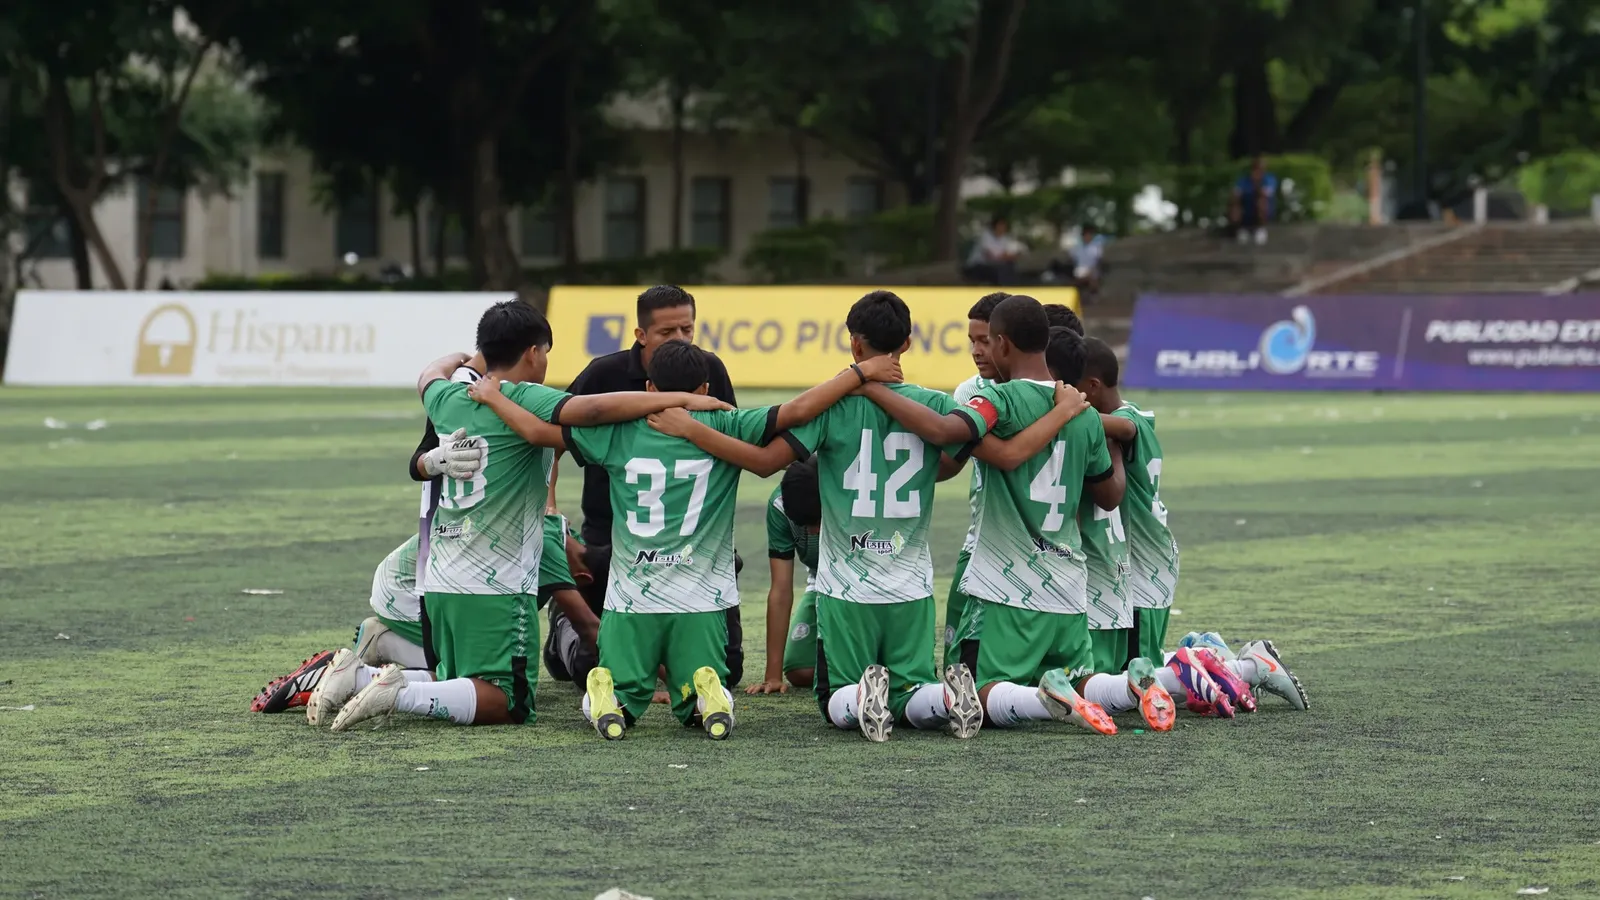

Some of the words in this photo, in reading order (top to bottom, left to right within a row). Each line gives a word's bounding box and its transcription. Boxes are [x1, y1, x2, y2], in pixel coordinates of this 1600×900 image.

[205, 308, 377, 362] Hispana
[697, 319, 784, 354] NCO
[1425, 319, 1560, 343] PUBLICIDAD
[624, 457, 714, 537] 37
[843, 428, 925, 518] 42
[1030, 440, 1066, 532] 4
